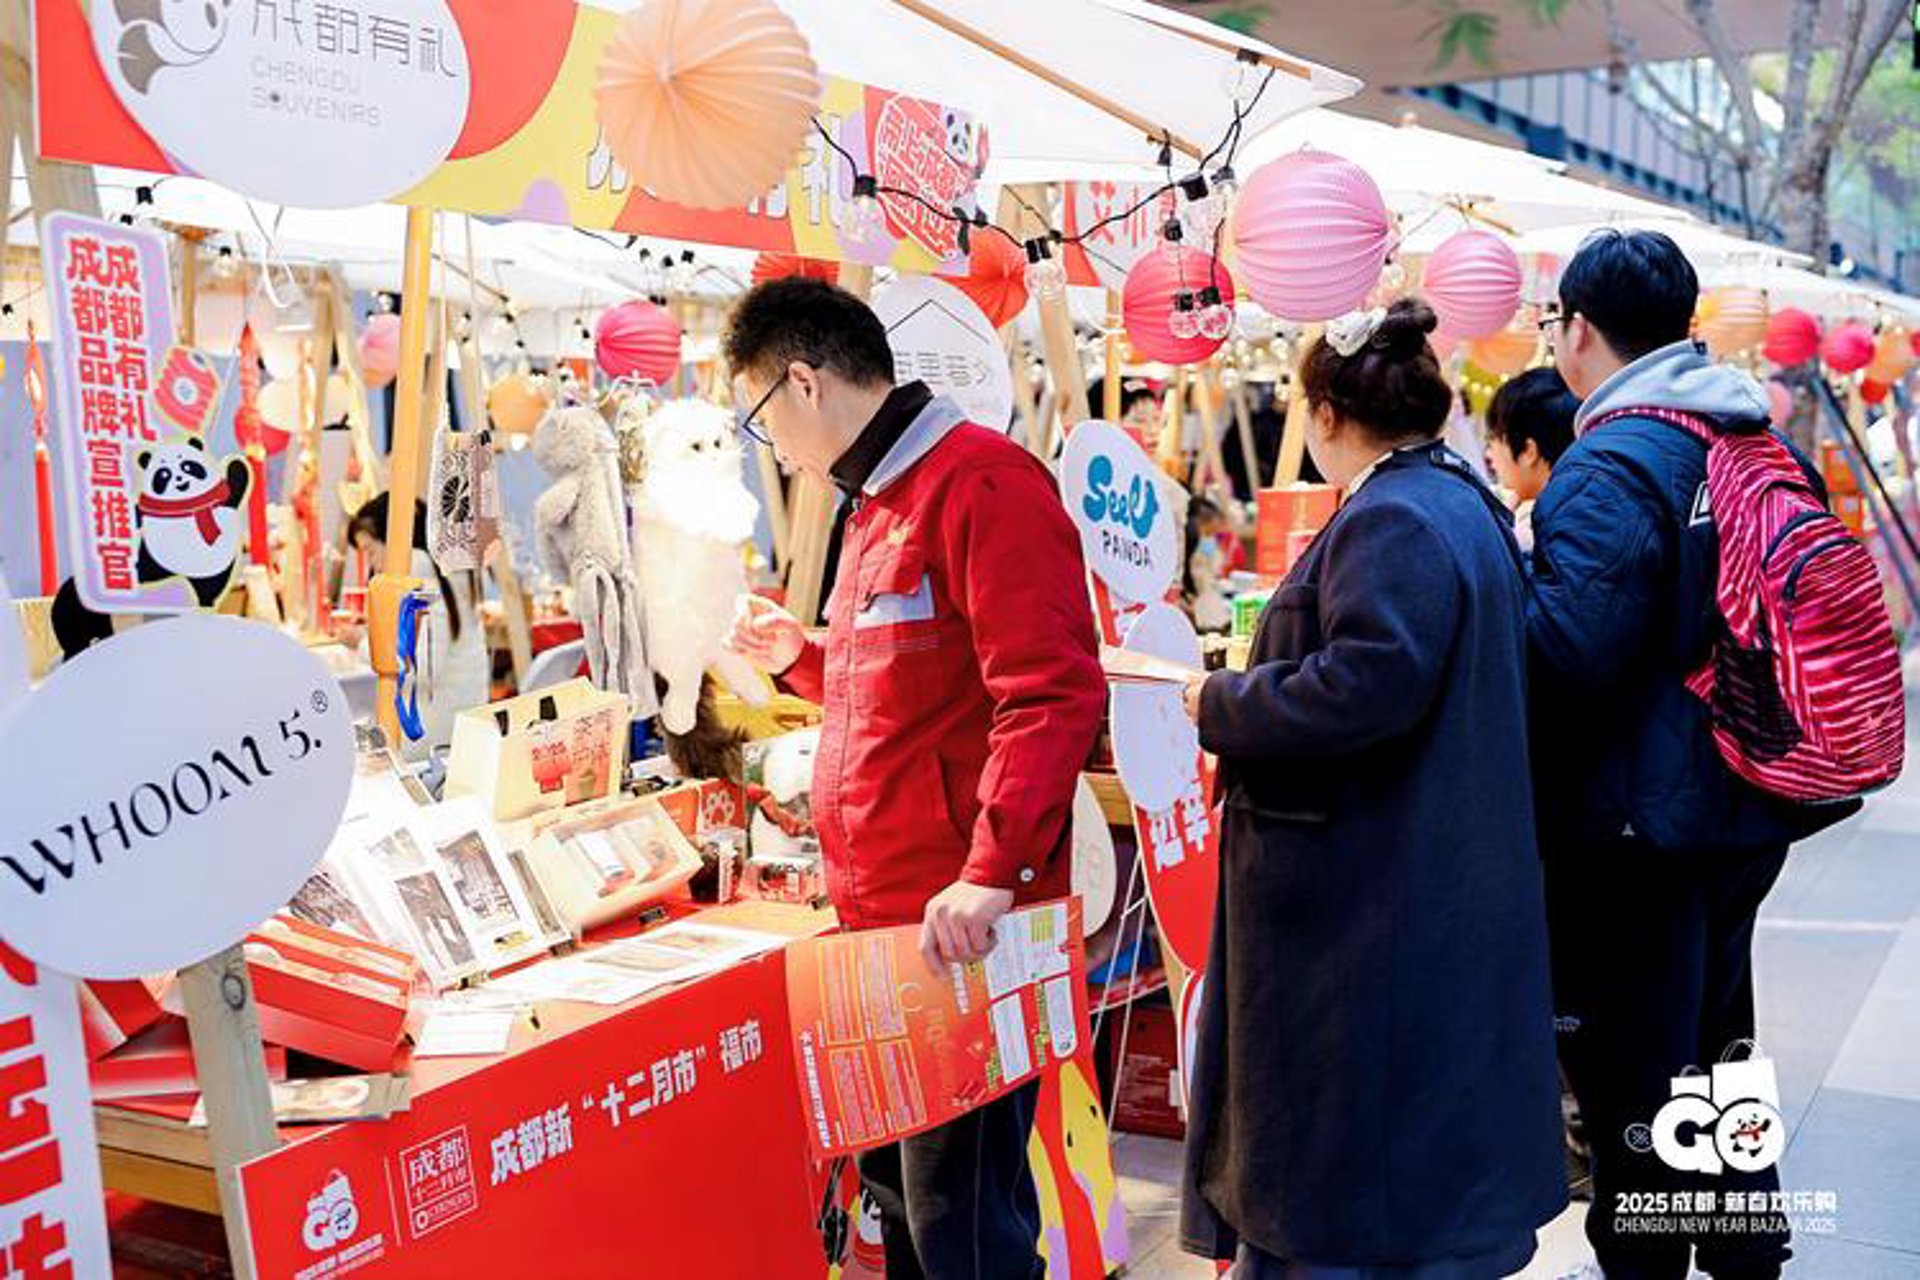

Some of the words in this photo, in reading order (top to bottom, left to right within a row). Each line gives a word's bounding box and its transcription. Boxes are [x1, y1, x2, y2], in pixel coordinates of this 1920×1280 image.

[253, 0, 457, 77] 成都有礼
[251, 55, 361, 94] CHENGDU
[106, 245, 157, 441] 成都有礼
[67, 237, 133, 590] 成都品牌宣推官
[1102, 529, 1154, 569] PANDA
[409, 1137, 465, 1186] 成都
